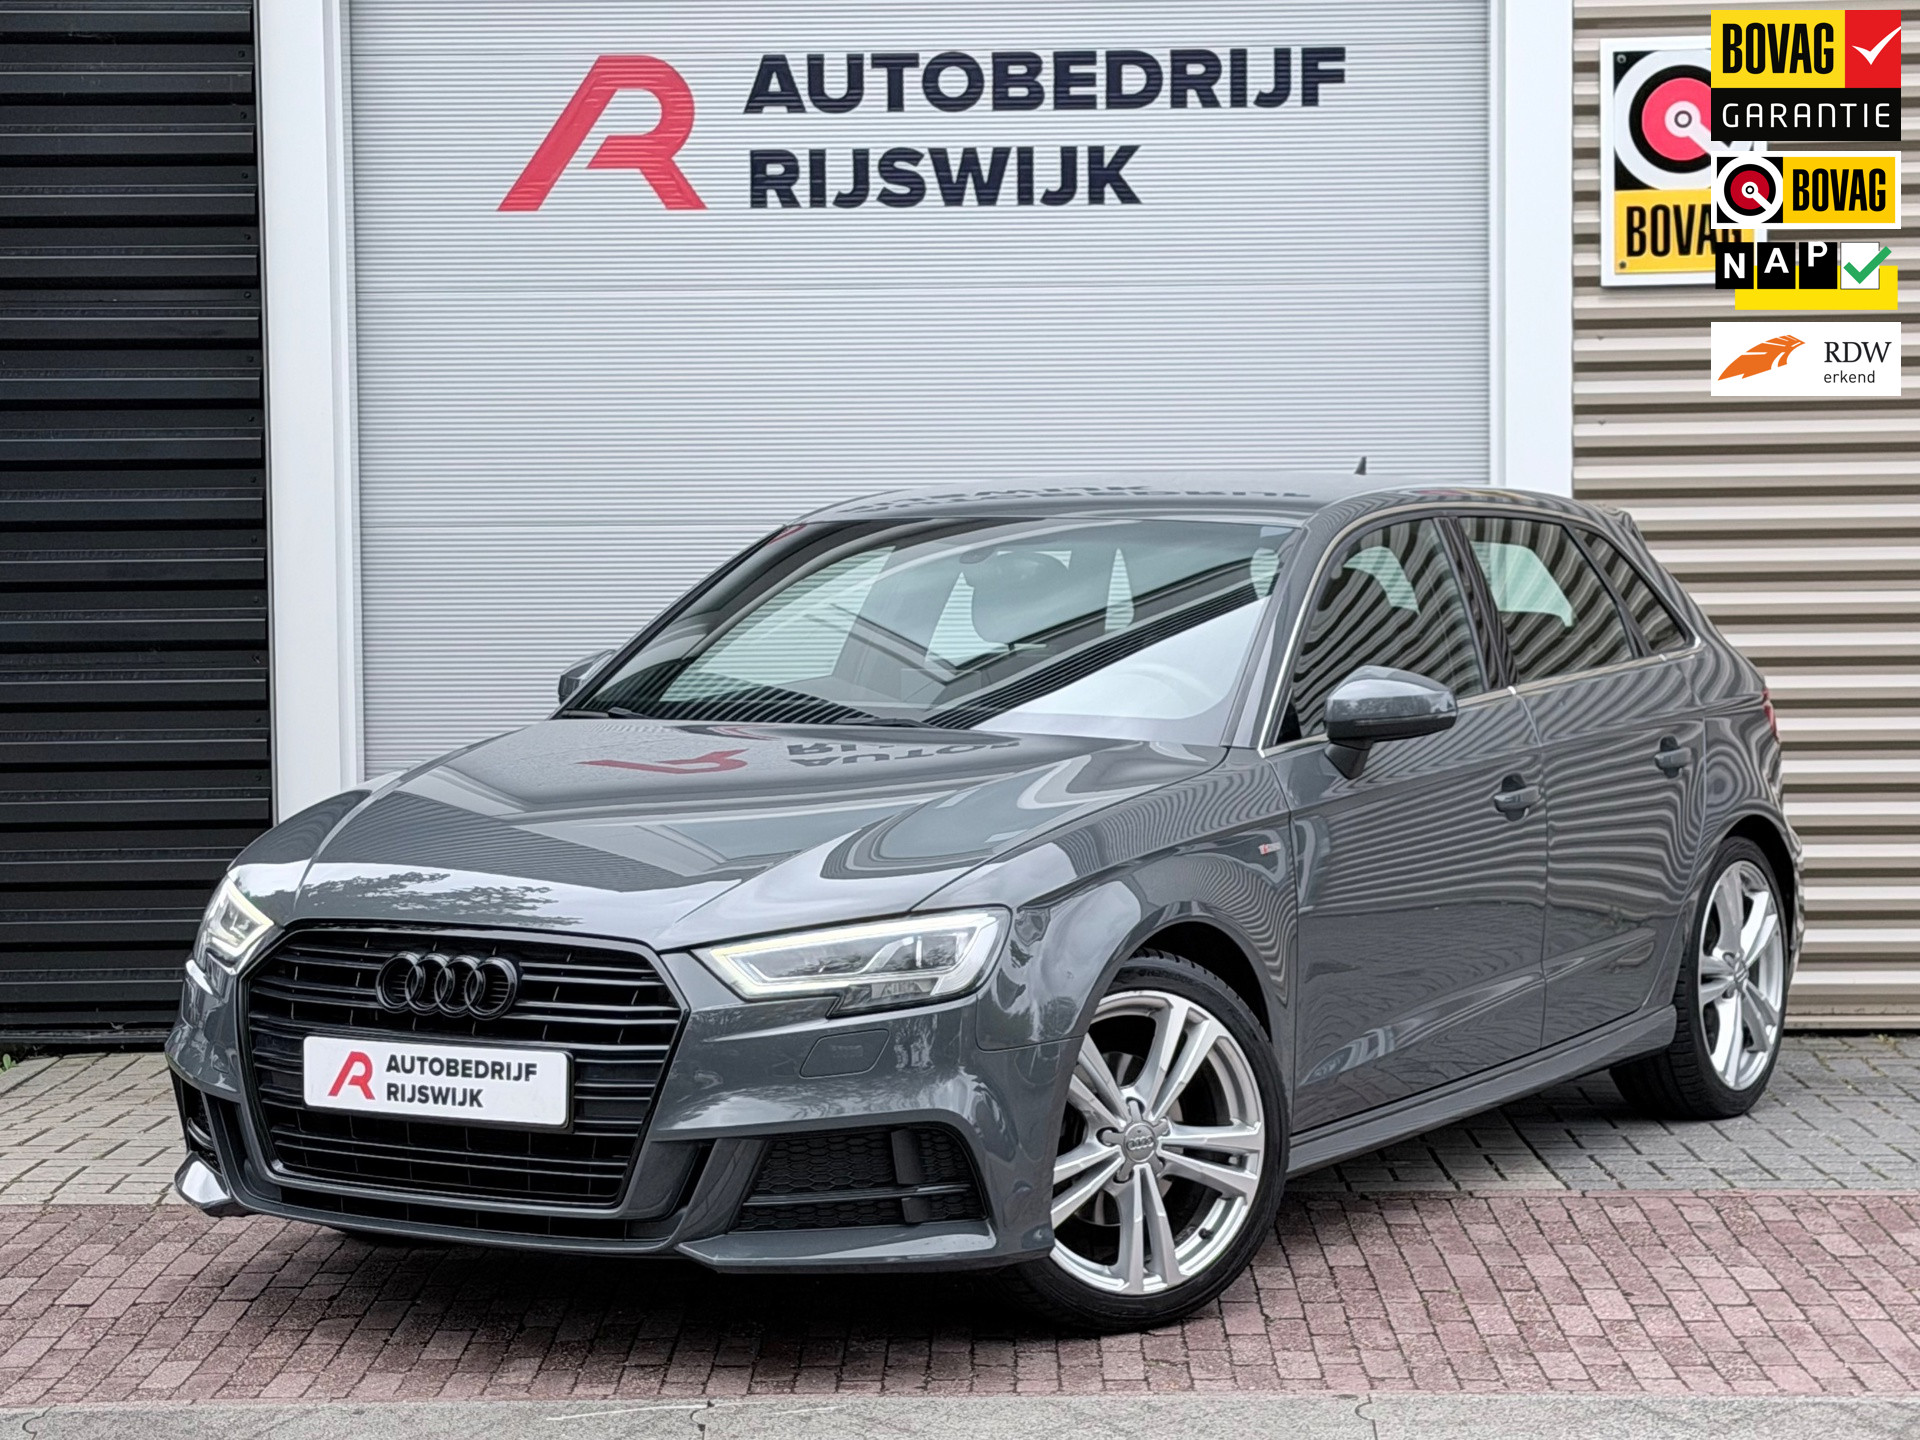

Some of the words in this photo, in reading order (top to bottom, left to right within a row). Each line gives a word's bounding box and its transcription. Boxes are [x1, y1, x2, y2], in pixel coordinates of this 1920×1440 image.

[743, 46, 1346, 114] AUTOBEDRIJF
[749, 145, 1141, 209] RIJSWIJK
[1626, 203, 1742, 257] BOVA
[386, 1054, 538, 1082] AUTOBEDRIJF
[386, 1082, 483, 1108] RIJSWIJK
